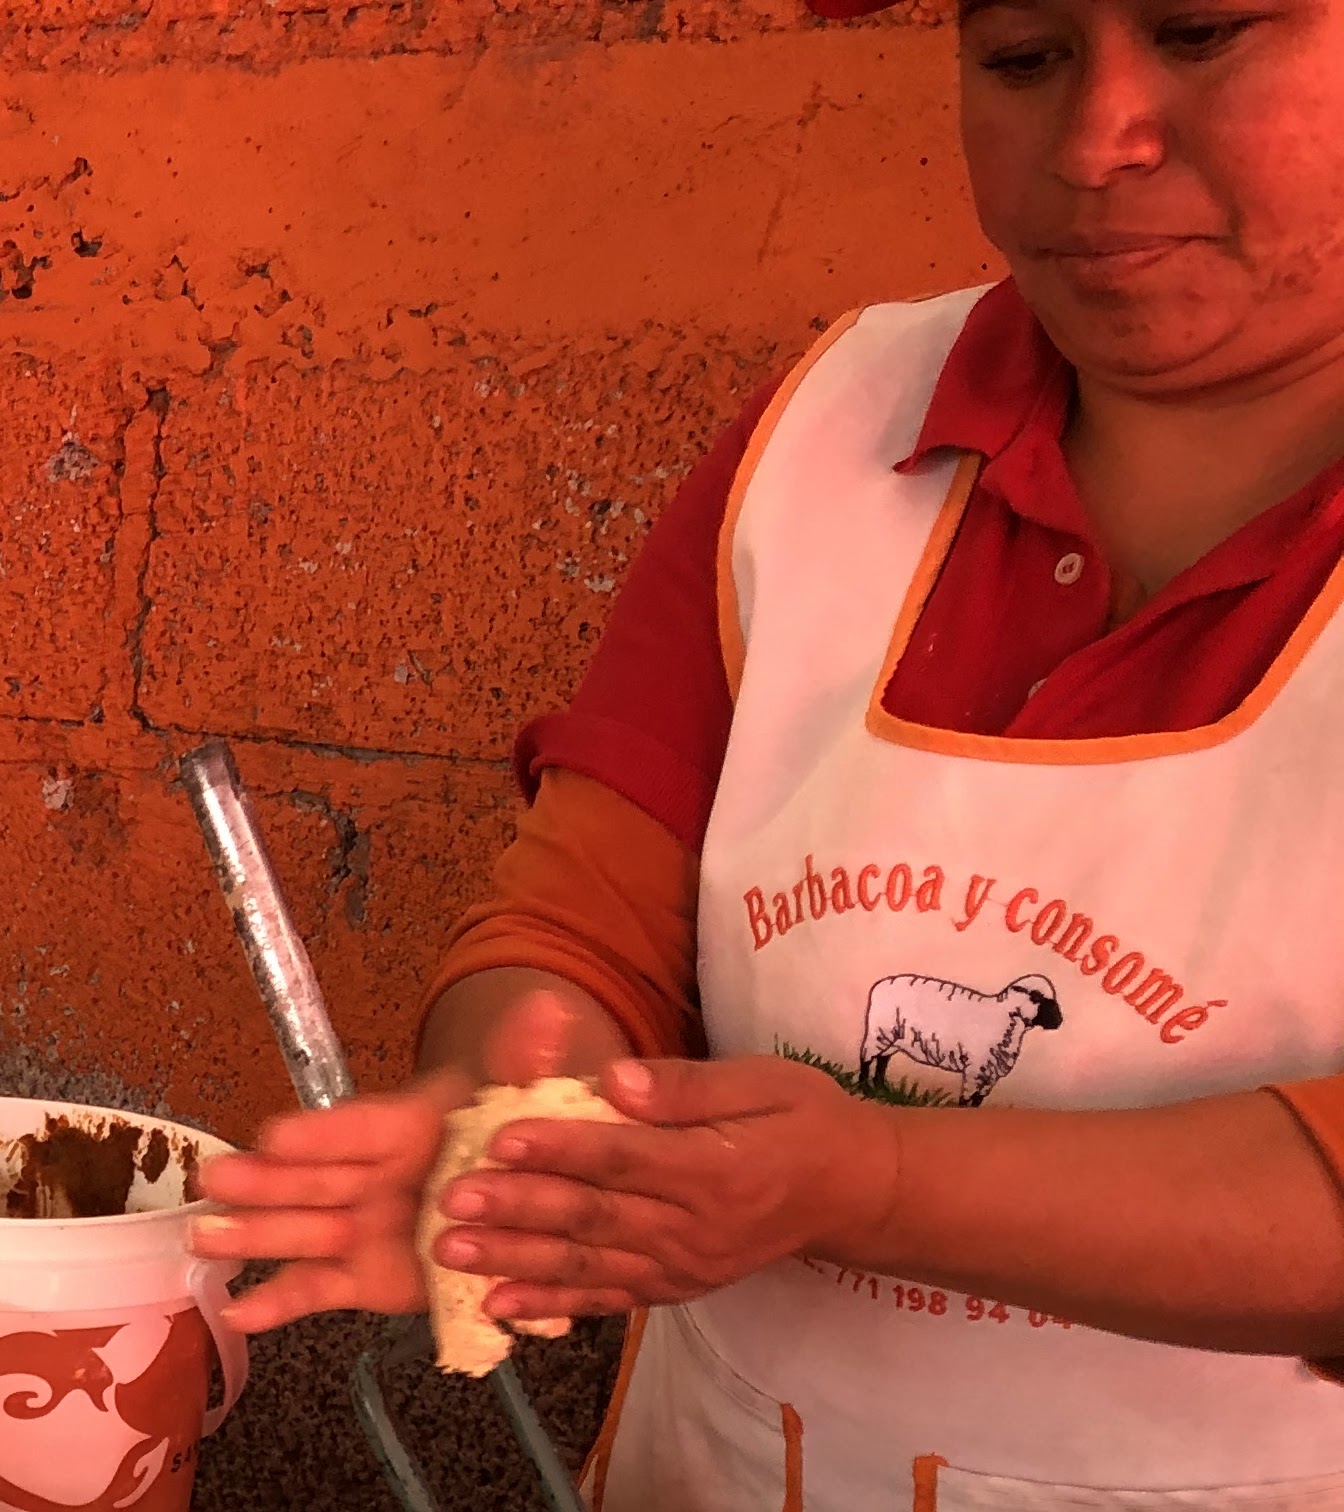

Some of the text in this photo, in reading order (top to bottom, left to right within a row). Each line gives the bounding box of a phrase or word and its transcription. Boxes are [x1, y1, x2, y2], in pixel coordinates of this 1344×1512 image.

[743, 854, 1229, 1044] Barbacoa y consomé
[892, 1284, 948, 1316] 198
[964, 1294, 1011, 1324] 94
